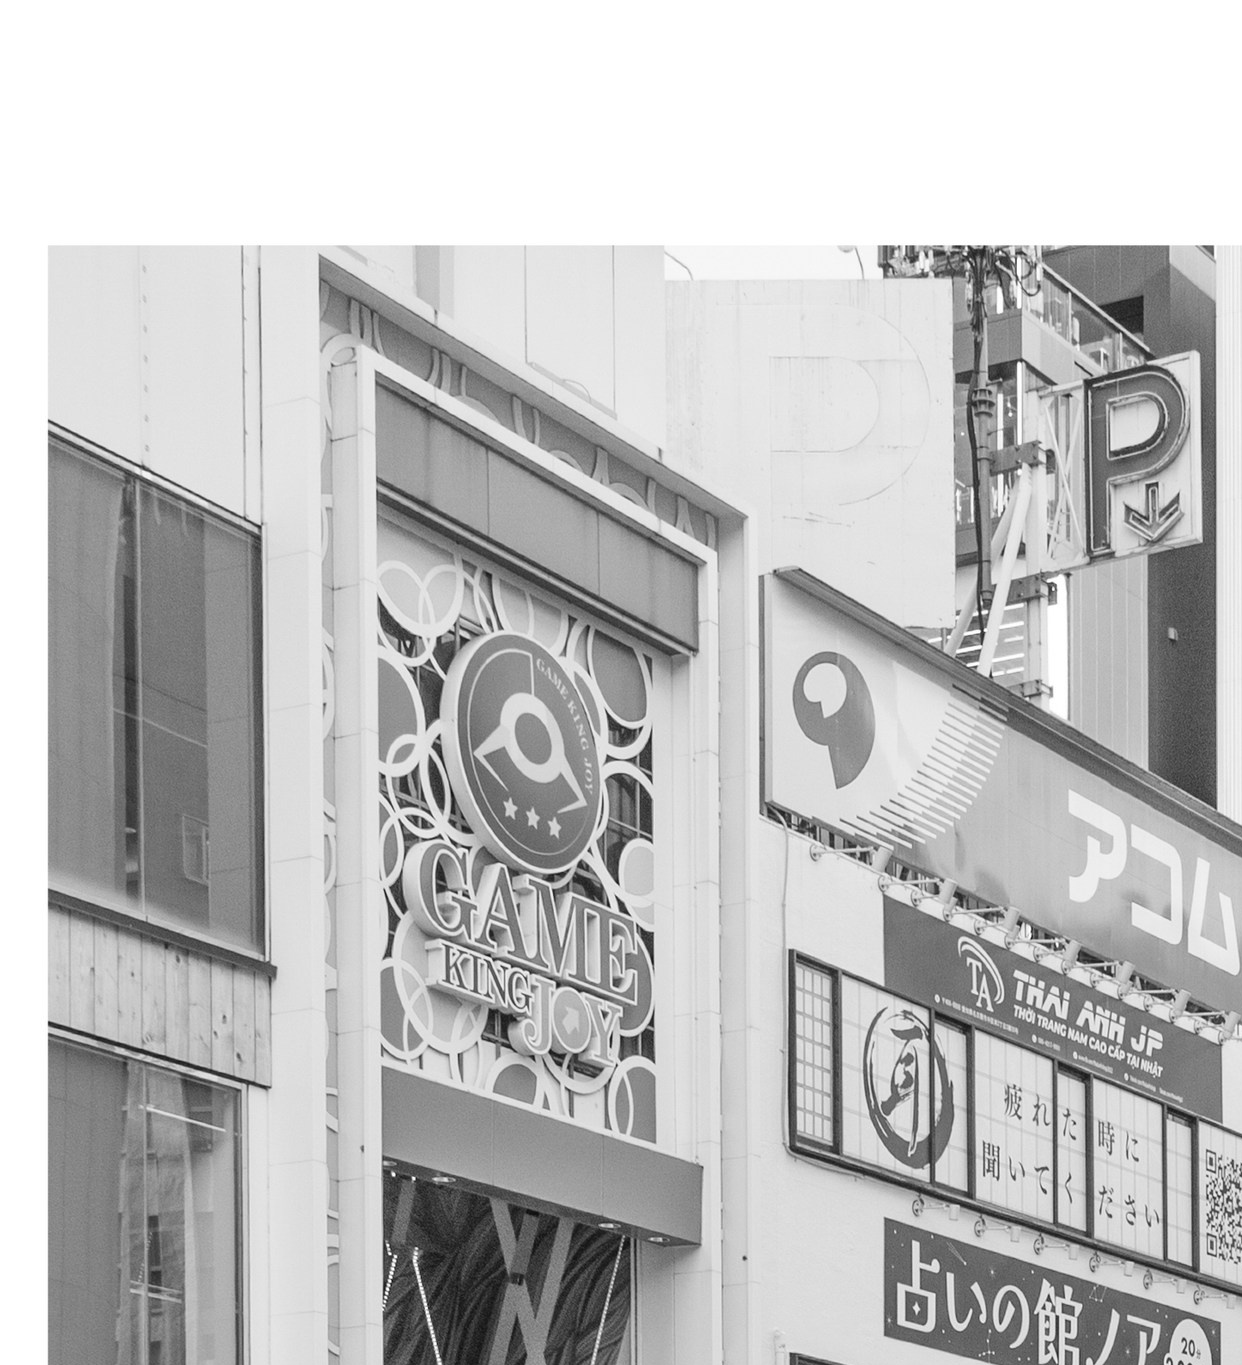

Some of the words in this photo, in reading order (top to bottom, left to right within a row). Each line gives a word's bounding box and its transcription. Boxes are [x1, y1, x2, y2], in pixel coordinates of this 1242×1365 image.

[1084, 364, 1191, 561] P
[536, 658, 568, 700] GAME
[567, 700, 589, 751] KING
[584, 757, 593, 795] JOY
[403, 841, 638, 1006] GAME
[1068, 788, 1241, 977] アコム
[438, 939, 533, 1017] KING
[512, 974, 624, 1068] JOY
[1036, 1015, 1067, 1037] TRANG
[1068, 1026, 1088, 1046] NAM
[1089, 1035, 1108, 1055] CAO
